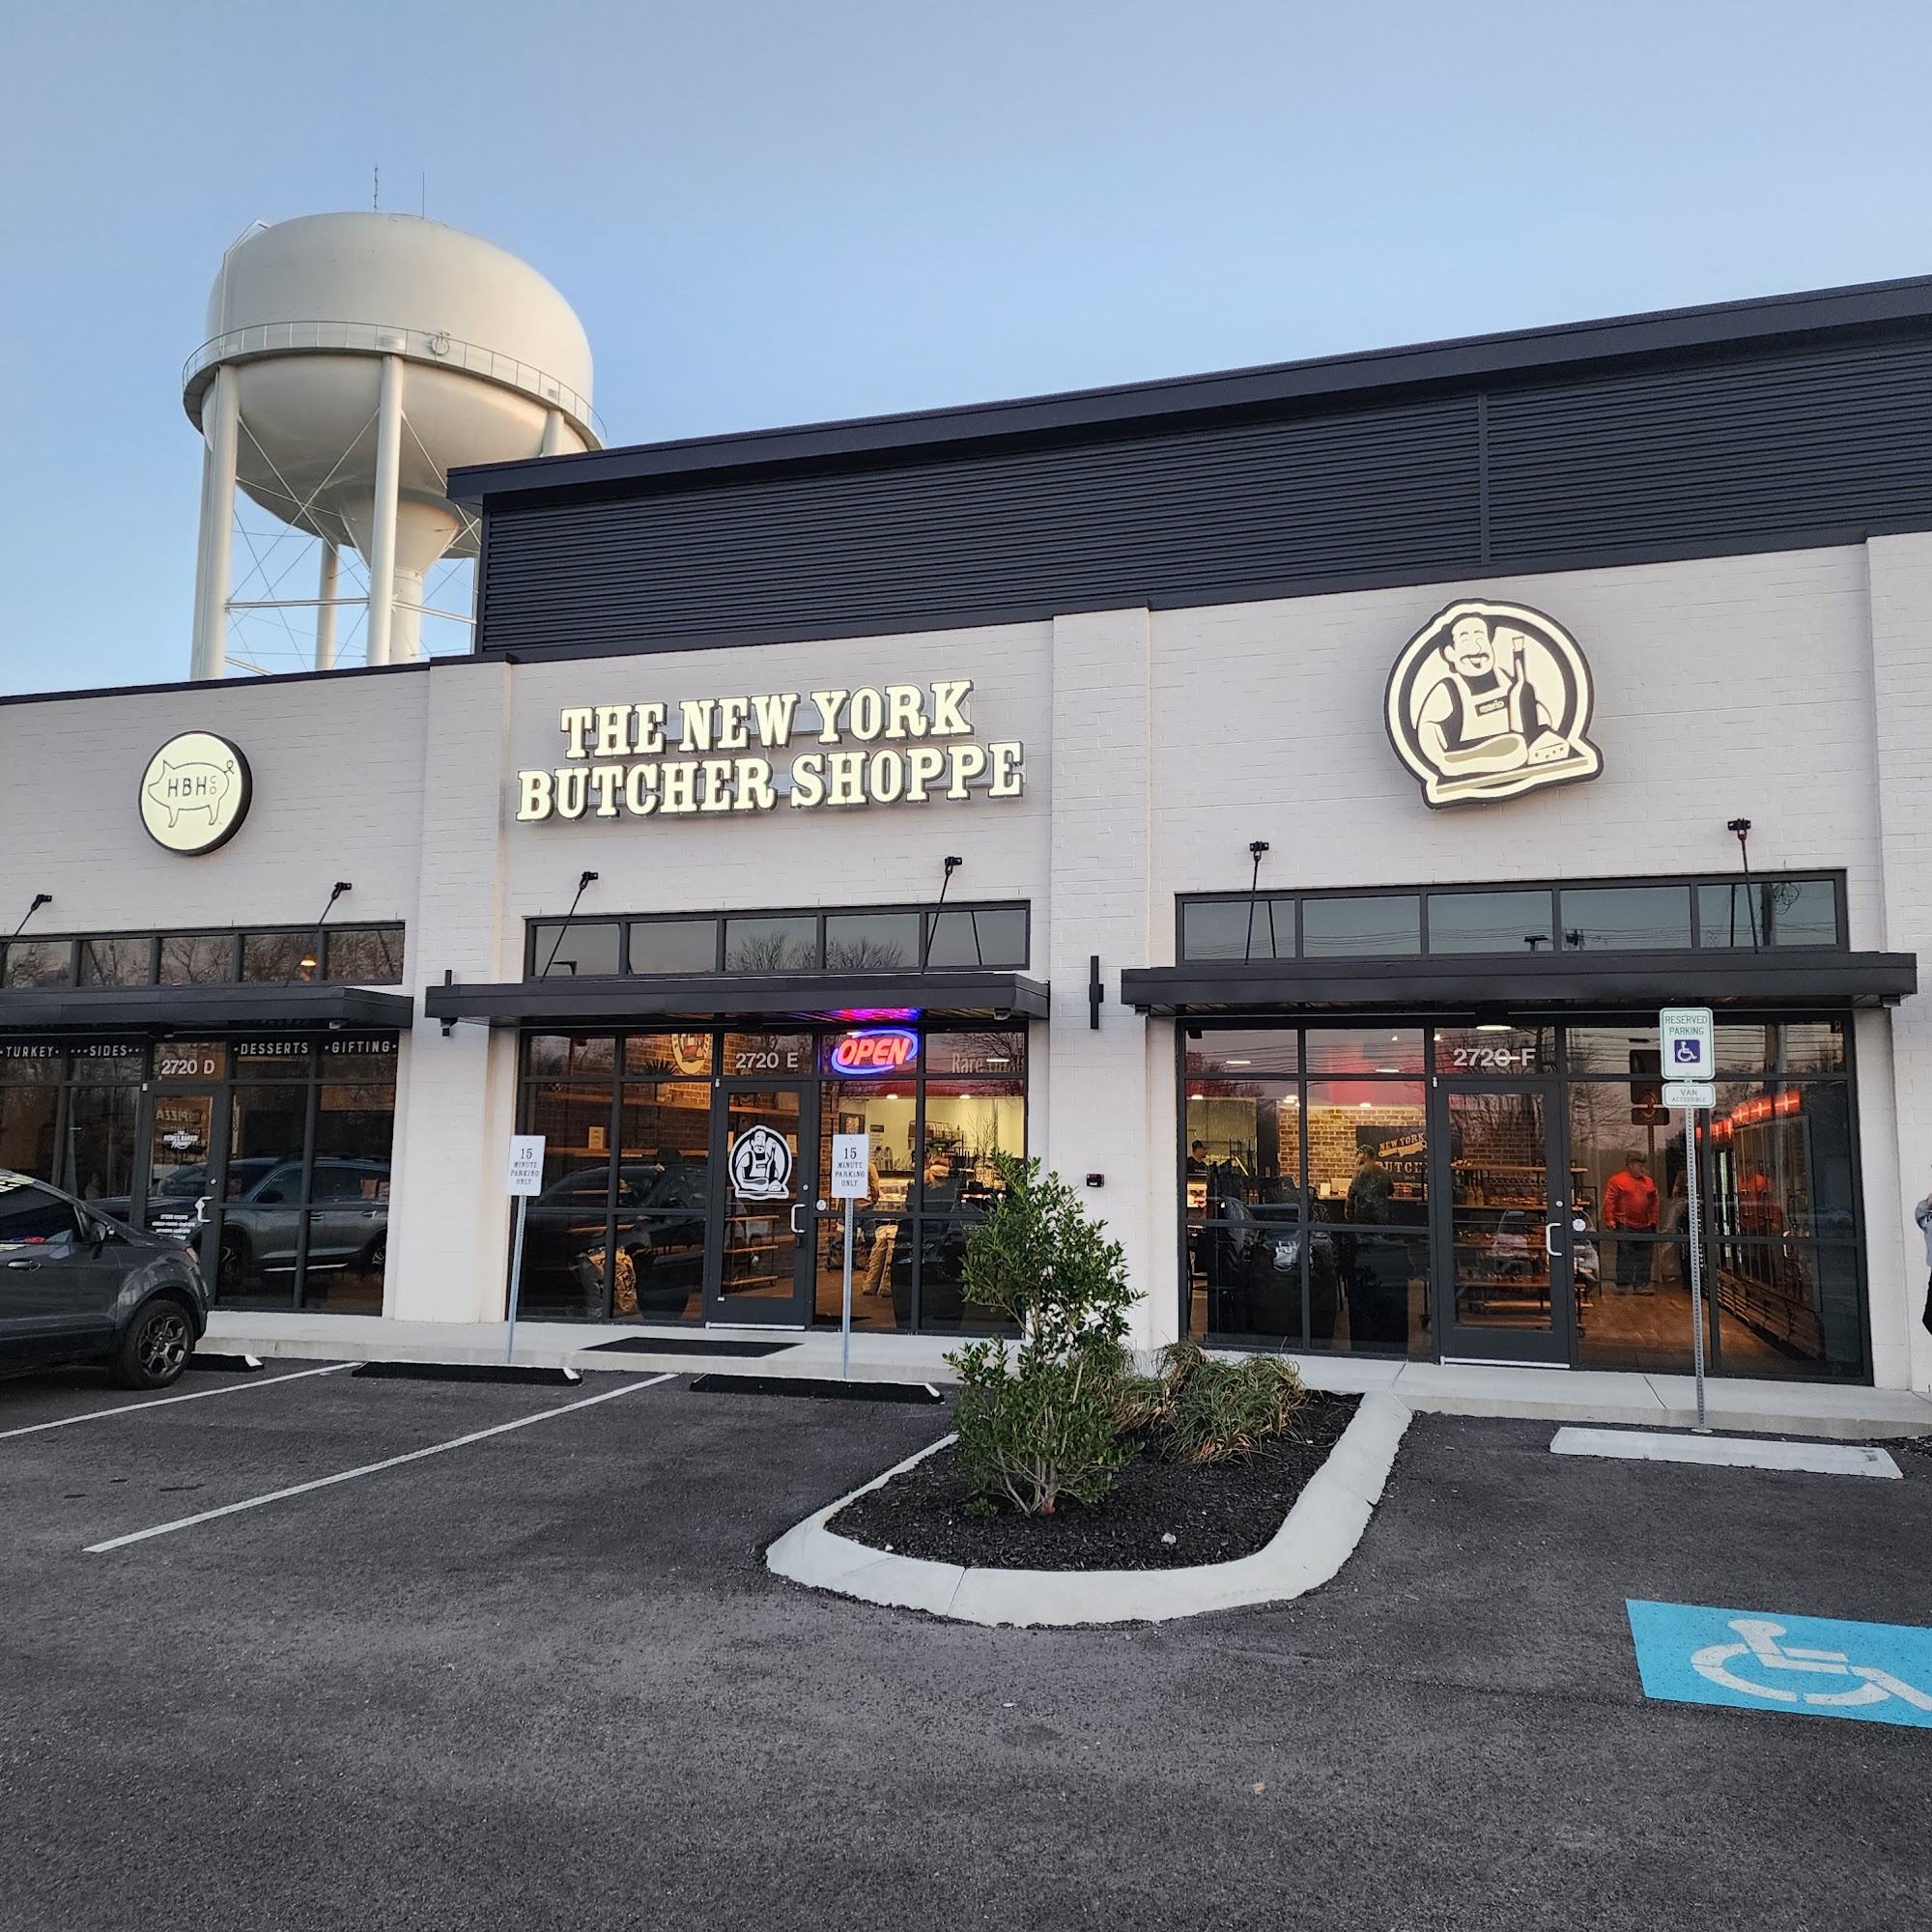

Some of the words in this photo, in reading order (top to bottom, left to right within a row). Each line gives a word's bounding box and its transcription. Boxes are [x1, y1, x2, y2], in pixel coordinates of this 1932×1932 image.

[561, 702, 668, 760] THE
[679, 692, 799, 753] NEW
[810, 679, 974, 745] YORK
[516, 756, 777, 822] BUTCHER
[790, 740, 1025, 810] SHOPPE
[1664, 1015, 1708, 1024] RESERVED
[1669, 1027, 1705, 1036] PARKING
[6, 1046, 54, 1058] TURKEY
[89, 1045, 128, 1057] SIDES
[241, 1041, 309, 1055] DESSERTS
[331, 1040, 390, 1054] GIFTING
[838, 1037, 911, 1066] OPEN
[735, 1052, 780, 1068] 2720
[786, 1052, 799, 1068] E
[952, 1052, 983, 1073] Rare
[1453, 1048, 1511, 1067] 2720
[1521, 1048, 1536, 1066] F
[160, 1059, 197, 1075] 2720
[203, 1059, 215, 1075] D
[1379, 1140, 1399, 1151] NEW
[1399, 1132, 1425, 1147] YORK
[521, 1148, 532, 1159] 15
[844, 1147, 857, 1159] 15
